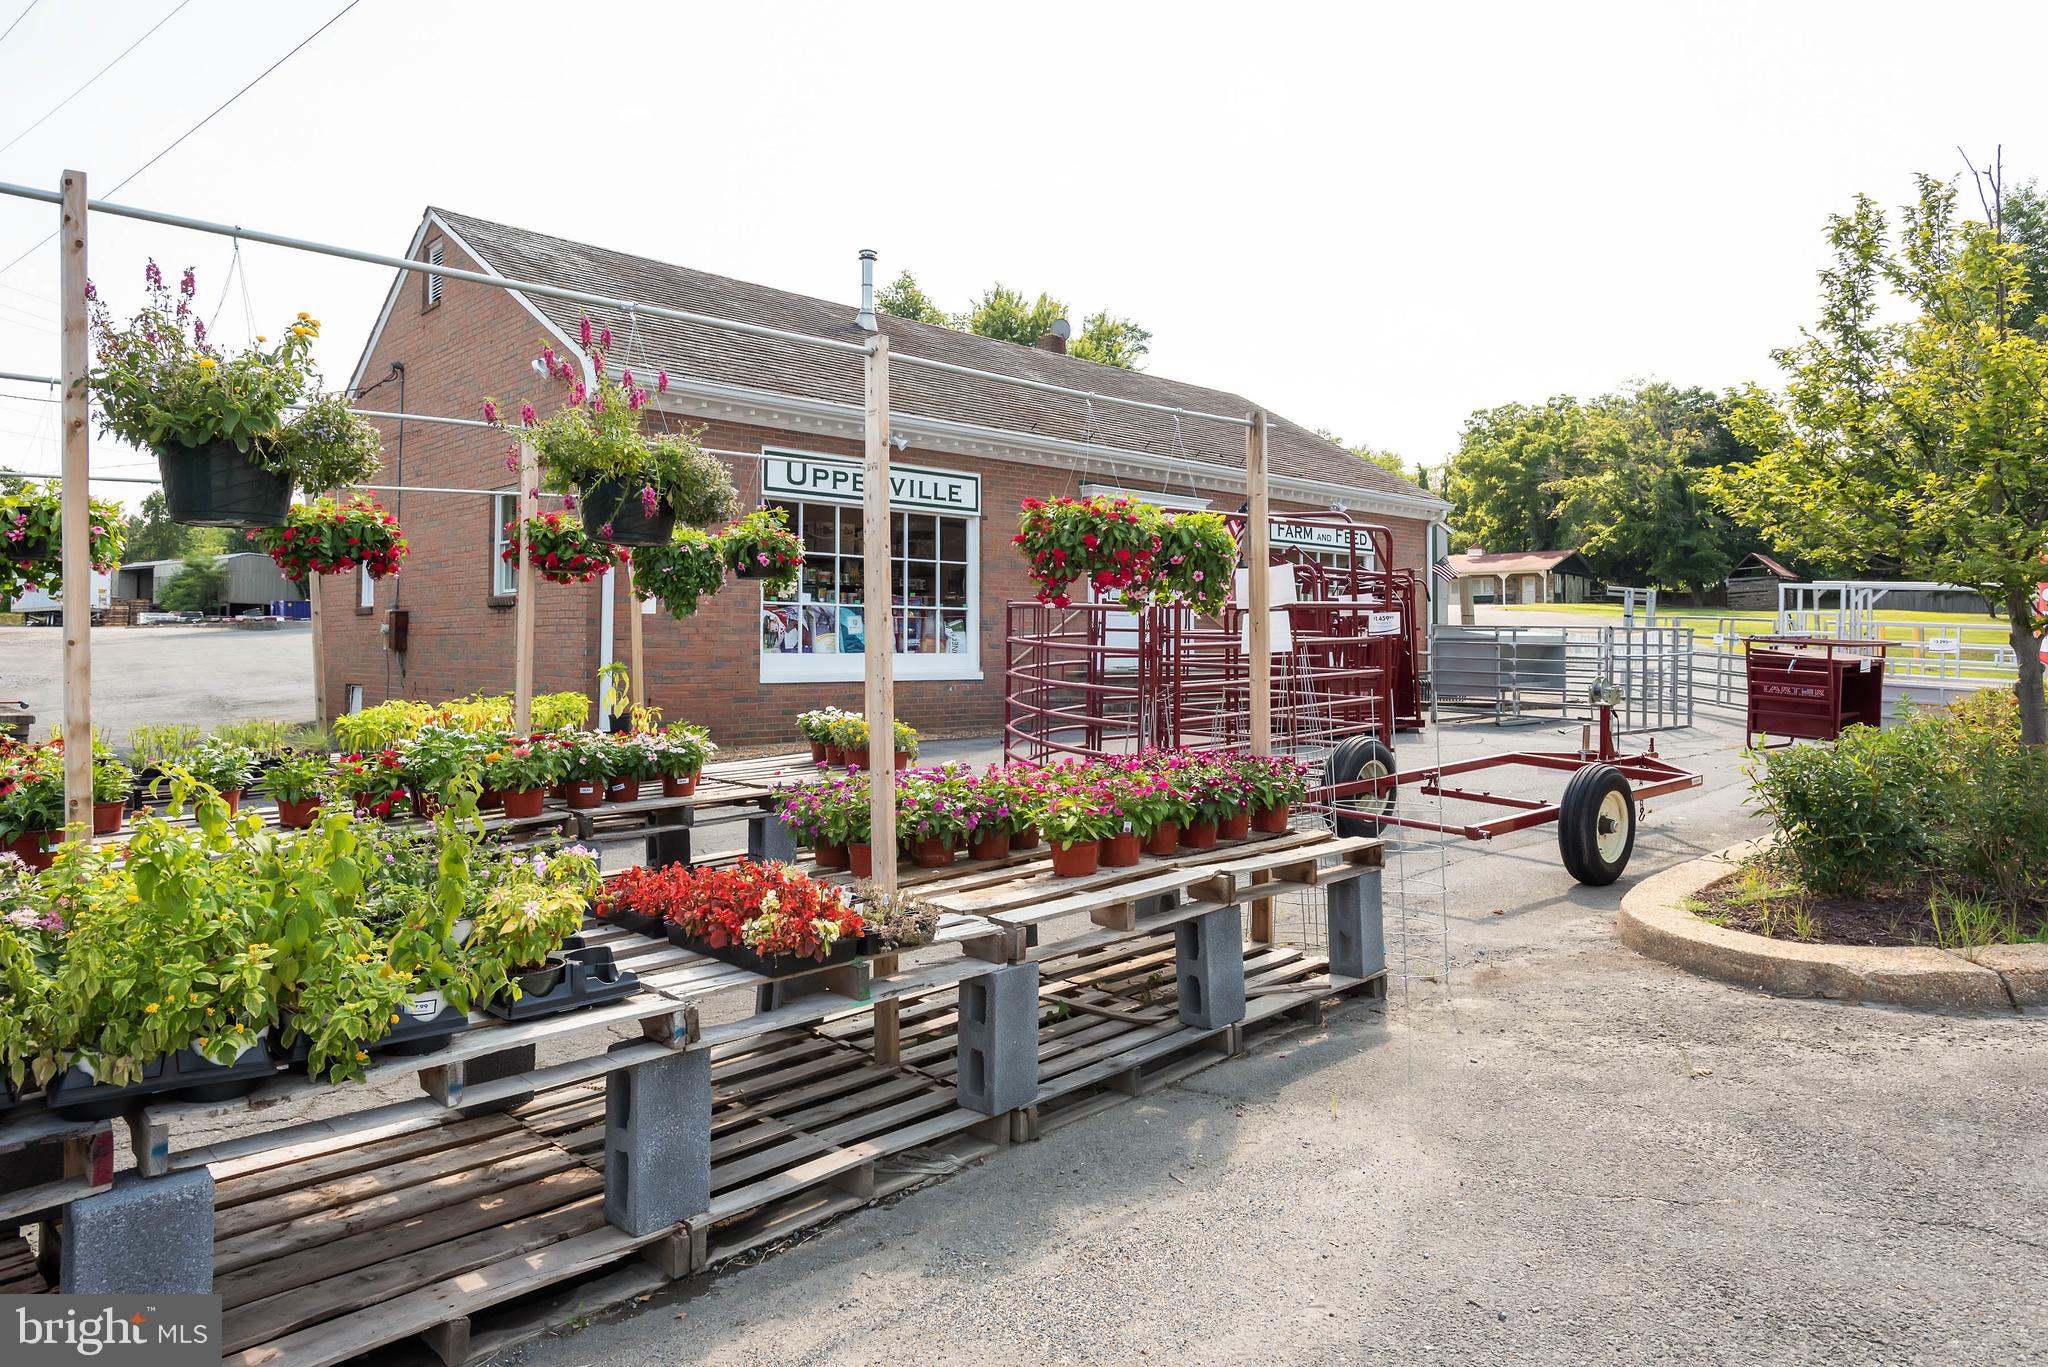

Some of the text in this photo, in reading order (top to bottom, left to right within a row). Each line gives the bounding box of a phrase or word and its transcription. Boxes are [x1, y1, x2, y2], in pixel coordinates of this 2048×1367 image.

[787, 462, 962, 503] UPPEVILLE
[1277, 523, 1313, 540] FARM
[1316, 534, 1332, 542] AND
